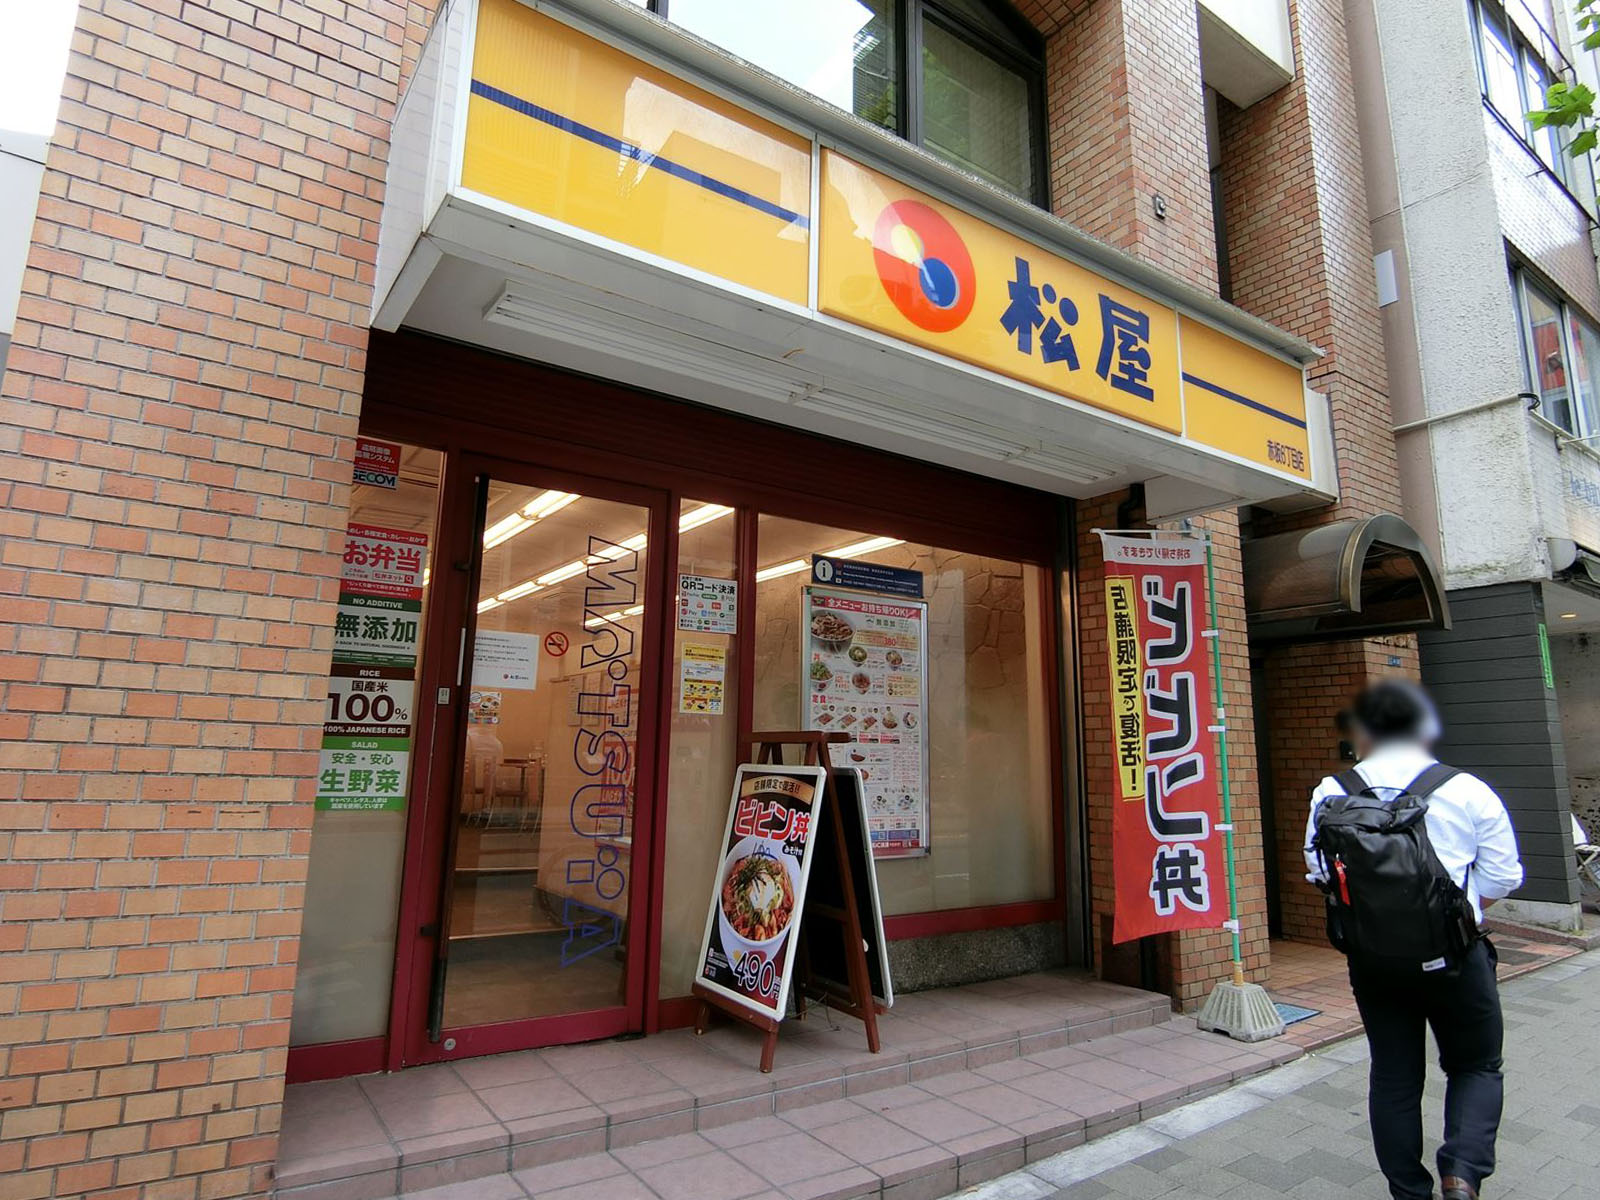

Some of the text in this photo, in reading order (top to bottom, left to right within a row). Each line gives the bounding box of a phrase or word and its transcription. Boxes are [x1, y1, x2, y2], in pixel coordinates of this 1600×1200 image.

[1000, 256, 1154, 402] 松屋
[353, 470, 396, 487] SECOM
[343, 540, 421, 574] お弁当
[681, 581, 735, 595] QRコード決済
[366, 599, 403, 609] ADDITIVE
[335, 611, 417, 644] 無添加
[359, 669, 381, 677] RICE
[351, 680, 389, 693] 国産米
[328, 692, 408, 723] 100%
[345, 726, 387, 735] JAPANESE
[387, 727, 406, 735] RICE
[351, 741, 378, 749] SALAD
[331, 752, 394, 766] 安全・安心
[319, 768, 400, 794] 生野菜
[735, 799, 811, 843] ビビン丼
